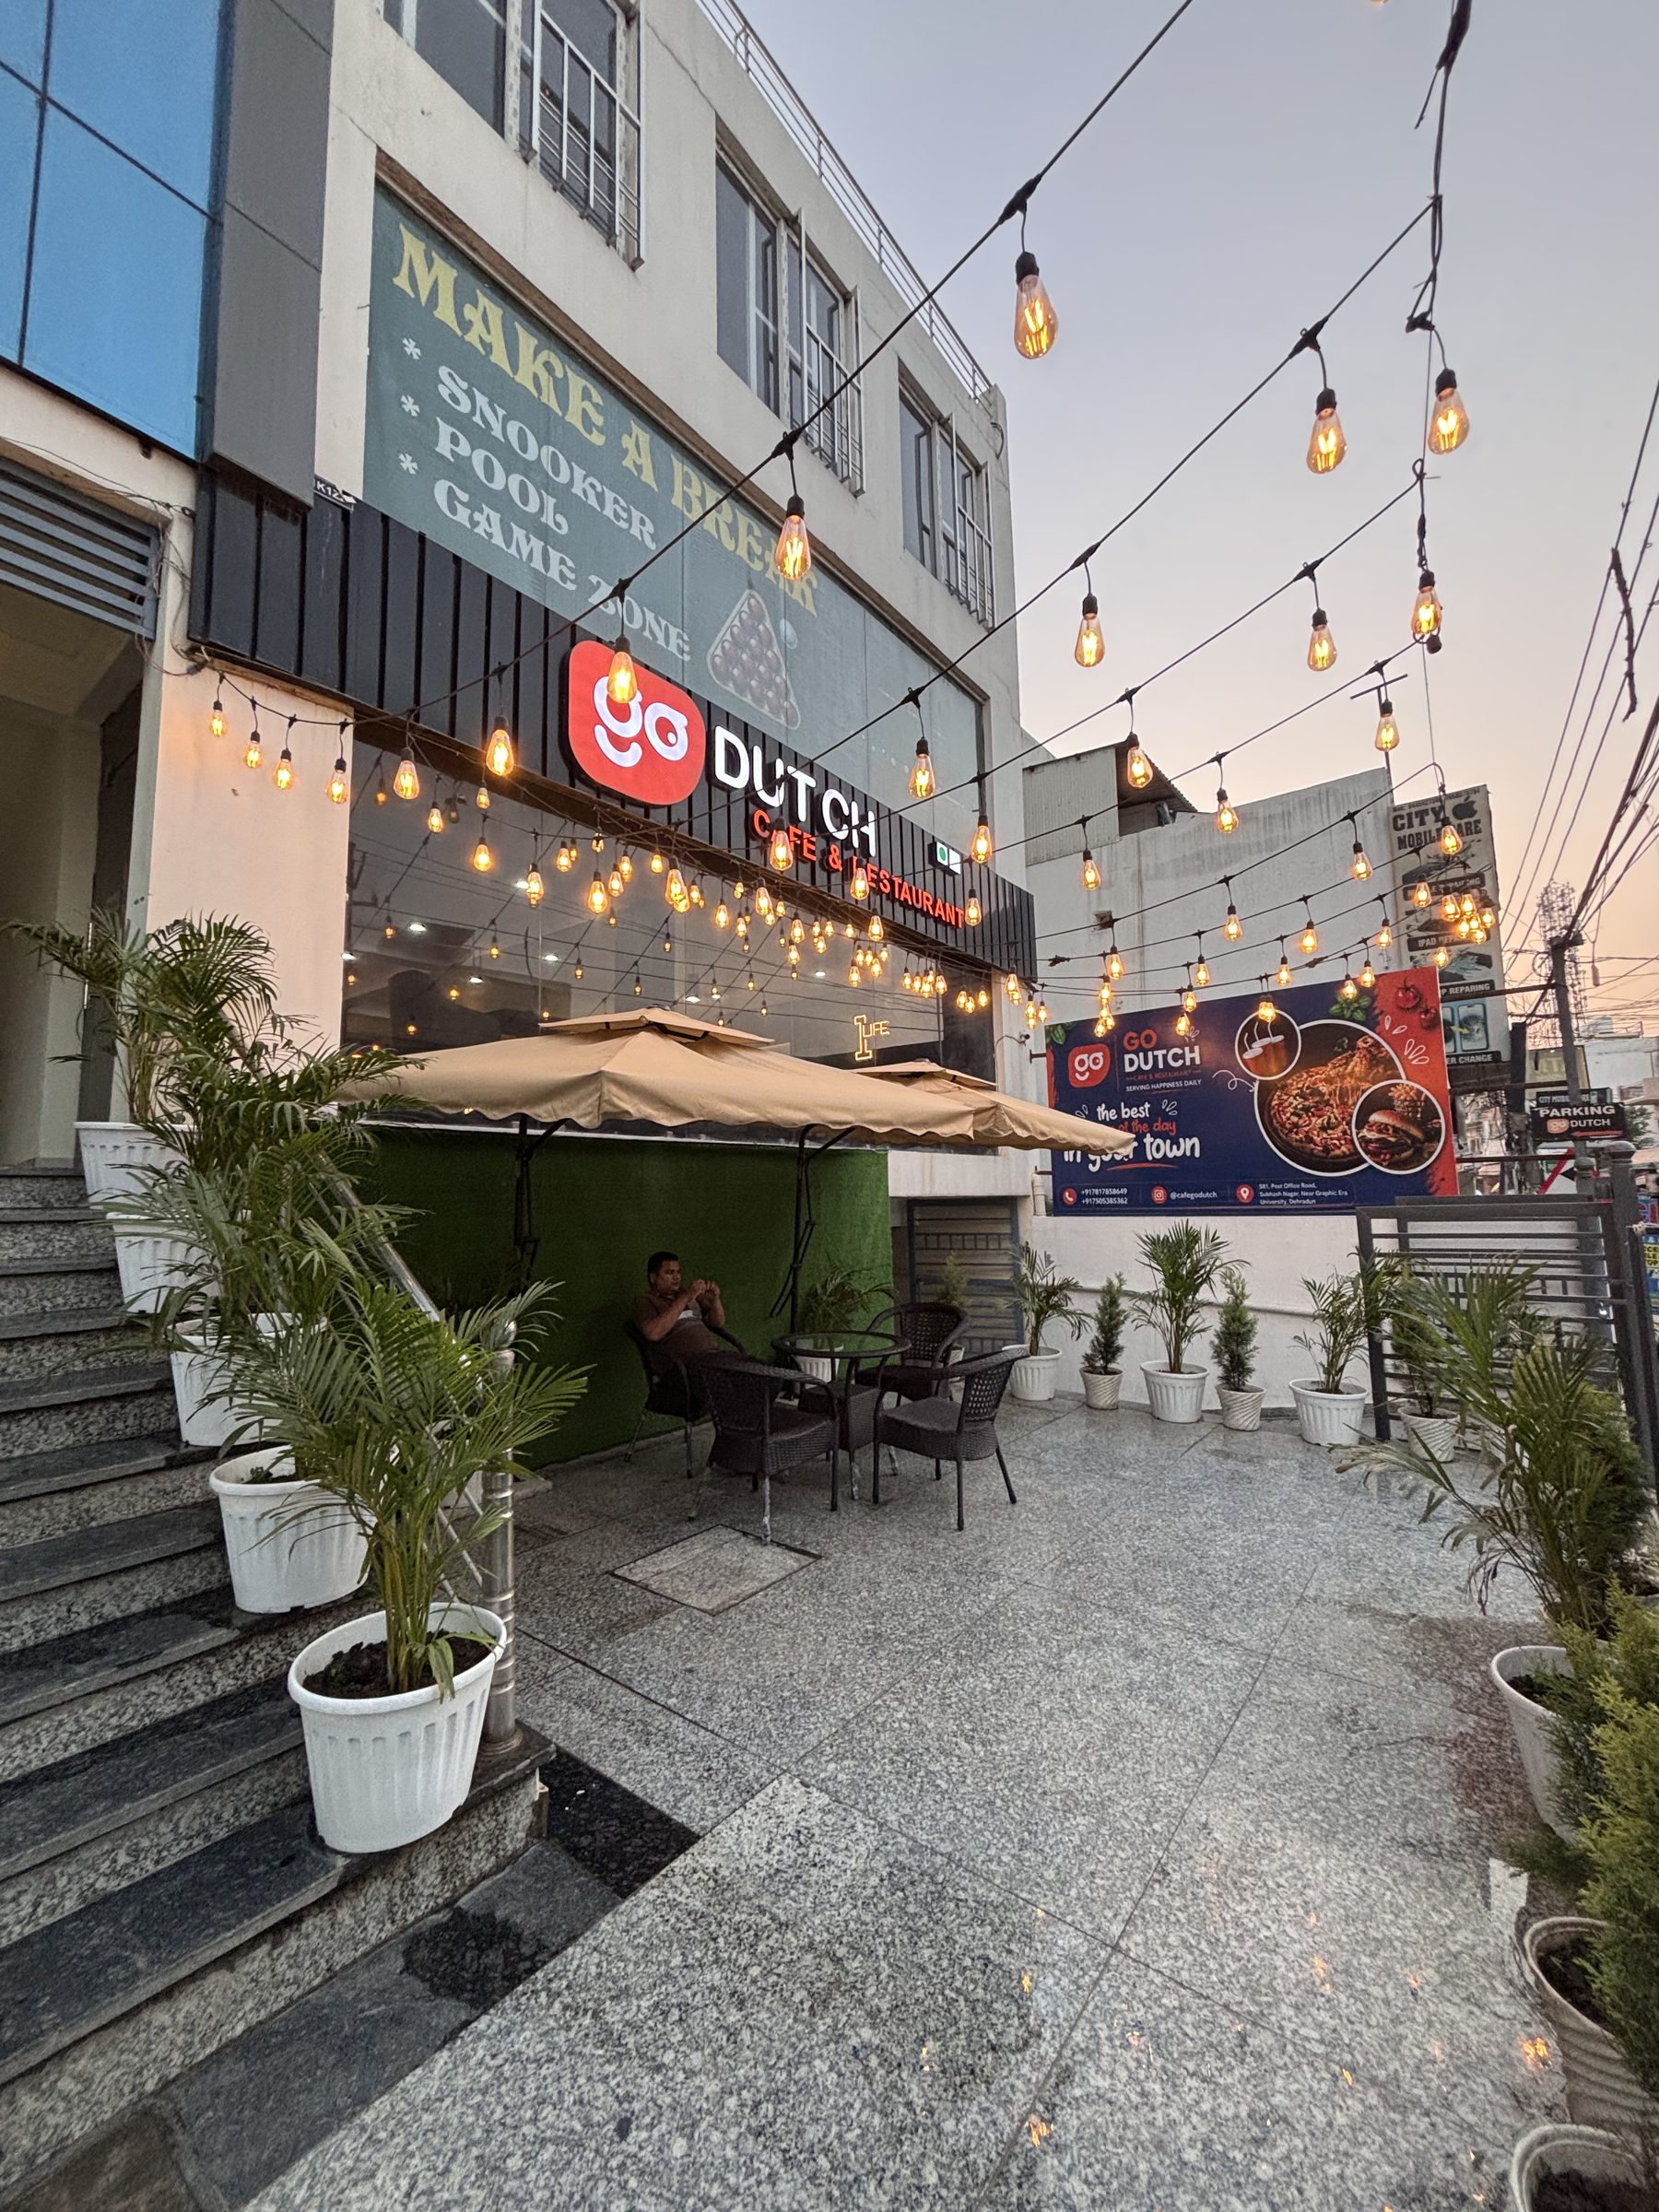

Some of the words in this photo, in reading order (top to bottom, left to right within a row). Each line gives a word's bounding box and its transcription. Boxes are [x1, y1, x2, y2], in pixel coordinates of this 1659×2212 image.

[393, 223, 606, 447] MAKE
[621, 420, 659, 492] A
[437, 365, 657, 550] SNOOKER
[435, 417, 569, 535] POOL
[433, 478, 578, 591] GAME
[588, 574, 691, 662] ZONE
[593, 676, 688, 768] go
[714, 725, 876, 857] DUTCH
[1393, 806, 1444, 831] CITY
[1452, 818, 1482, 839] ARE
[753, 809, 817, 862] CFE
[829, 843, 842, 872] &
[853, 855, 965, 929] ESTAURANT
[1449, 983, 1490, 995] REPARING
[1123, 1029, 1158, 1051] GO
[1074, 1052, 1104, 1081] go
[1124, 1045, 1201, 1073] DUTCH
[1458, 1053, 1493, 1065] CHANGE
[1125, 1083, 1151, 1092] SERVING
[1151, 1080, 1183, 1089] HAPPINESS
[1183, 1078, 1202, 1087] DAILY
[1097, 1103, 1118, 1122] the
[1121, 1101, 1151, 1119] best
[1539, 1105, 1616, 1118] PARKING
[1571, 1118, 1611, 1127] DUTCH
[1131, 1119, 1150, 1134] the
[1153, 1116, 1177, 1136] day
[1143, 1132, 1201, 1161] town
[1170, 1191, 1218, 1200] @cafegodutch
